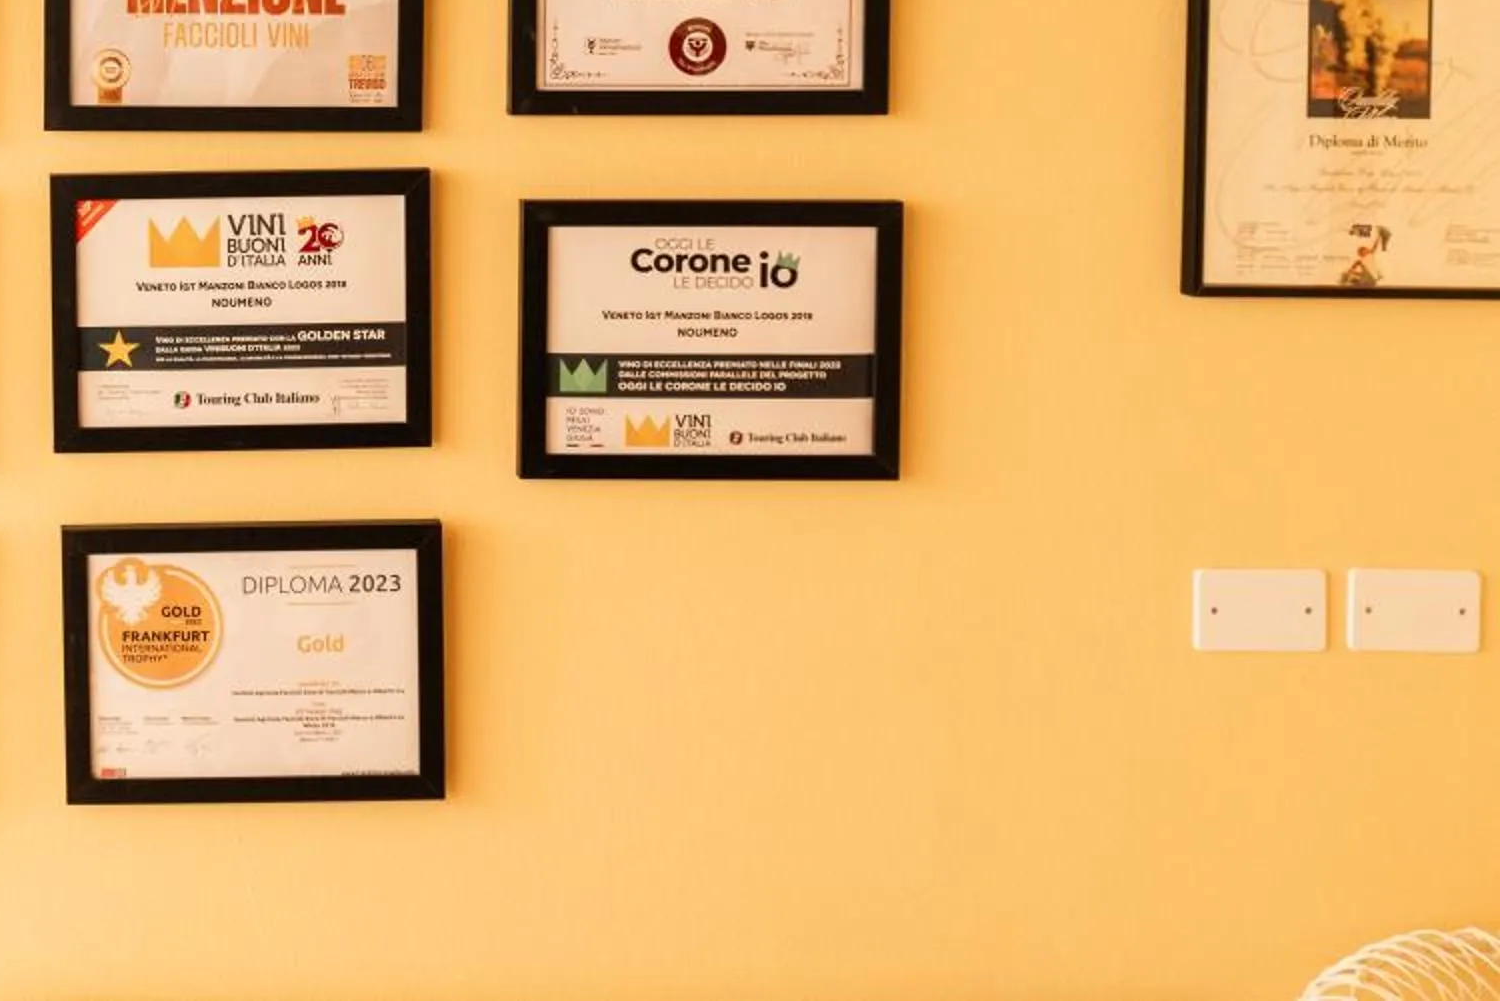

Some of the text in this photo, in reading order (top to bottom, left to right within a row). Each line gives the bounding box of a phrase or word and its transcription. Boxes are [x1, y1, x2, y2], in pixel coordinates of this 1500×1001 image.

[163, 22, 310, 48] FACCIOLI VINI
[1309, 135, 1427, 149] Diploma di Merito
[228, 213, 286, 236] VINI
[228, 238, 285, 254] BUONI
[655, 238, 715, 250] OGGI LE
[228, 254, 286, 268] D'ITALIA
[298, 254, 333, 267] ANNI
[631, 249, 798, 288] Corone io
[673, 277, 754, 289] LE DECIDO
[212, 297, 272, 308] NOUMENO
[298, 330, 385, 342] GOLDEN STAR
[677, 328, 737, 338] NOUMENO
[618, 382, 787, 391] OGGI LE CORONE LE DECIDO IO
[196, 392, 320, 407] Touring Club Italiano
[674, 415, 711, 428] VINI
[674, 429, 711, 439] BUONI
[748, 432, 846, 444] Touring Club Italiano
[242, 575, 401, 594] DIPLOMA 2023
[161, 606, 202, 618] GOLD
[122, 631, 210, 642] FRANKFURT
[121, 644, 202, 653] INTERNATIONAL
[297, 634, 345, 653] Gold
